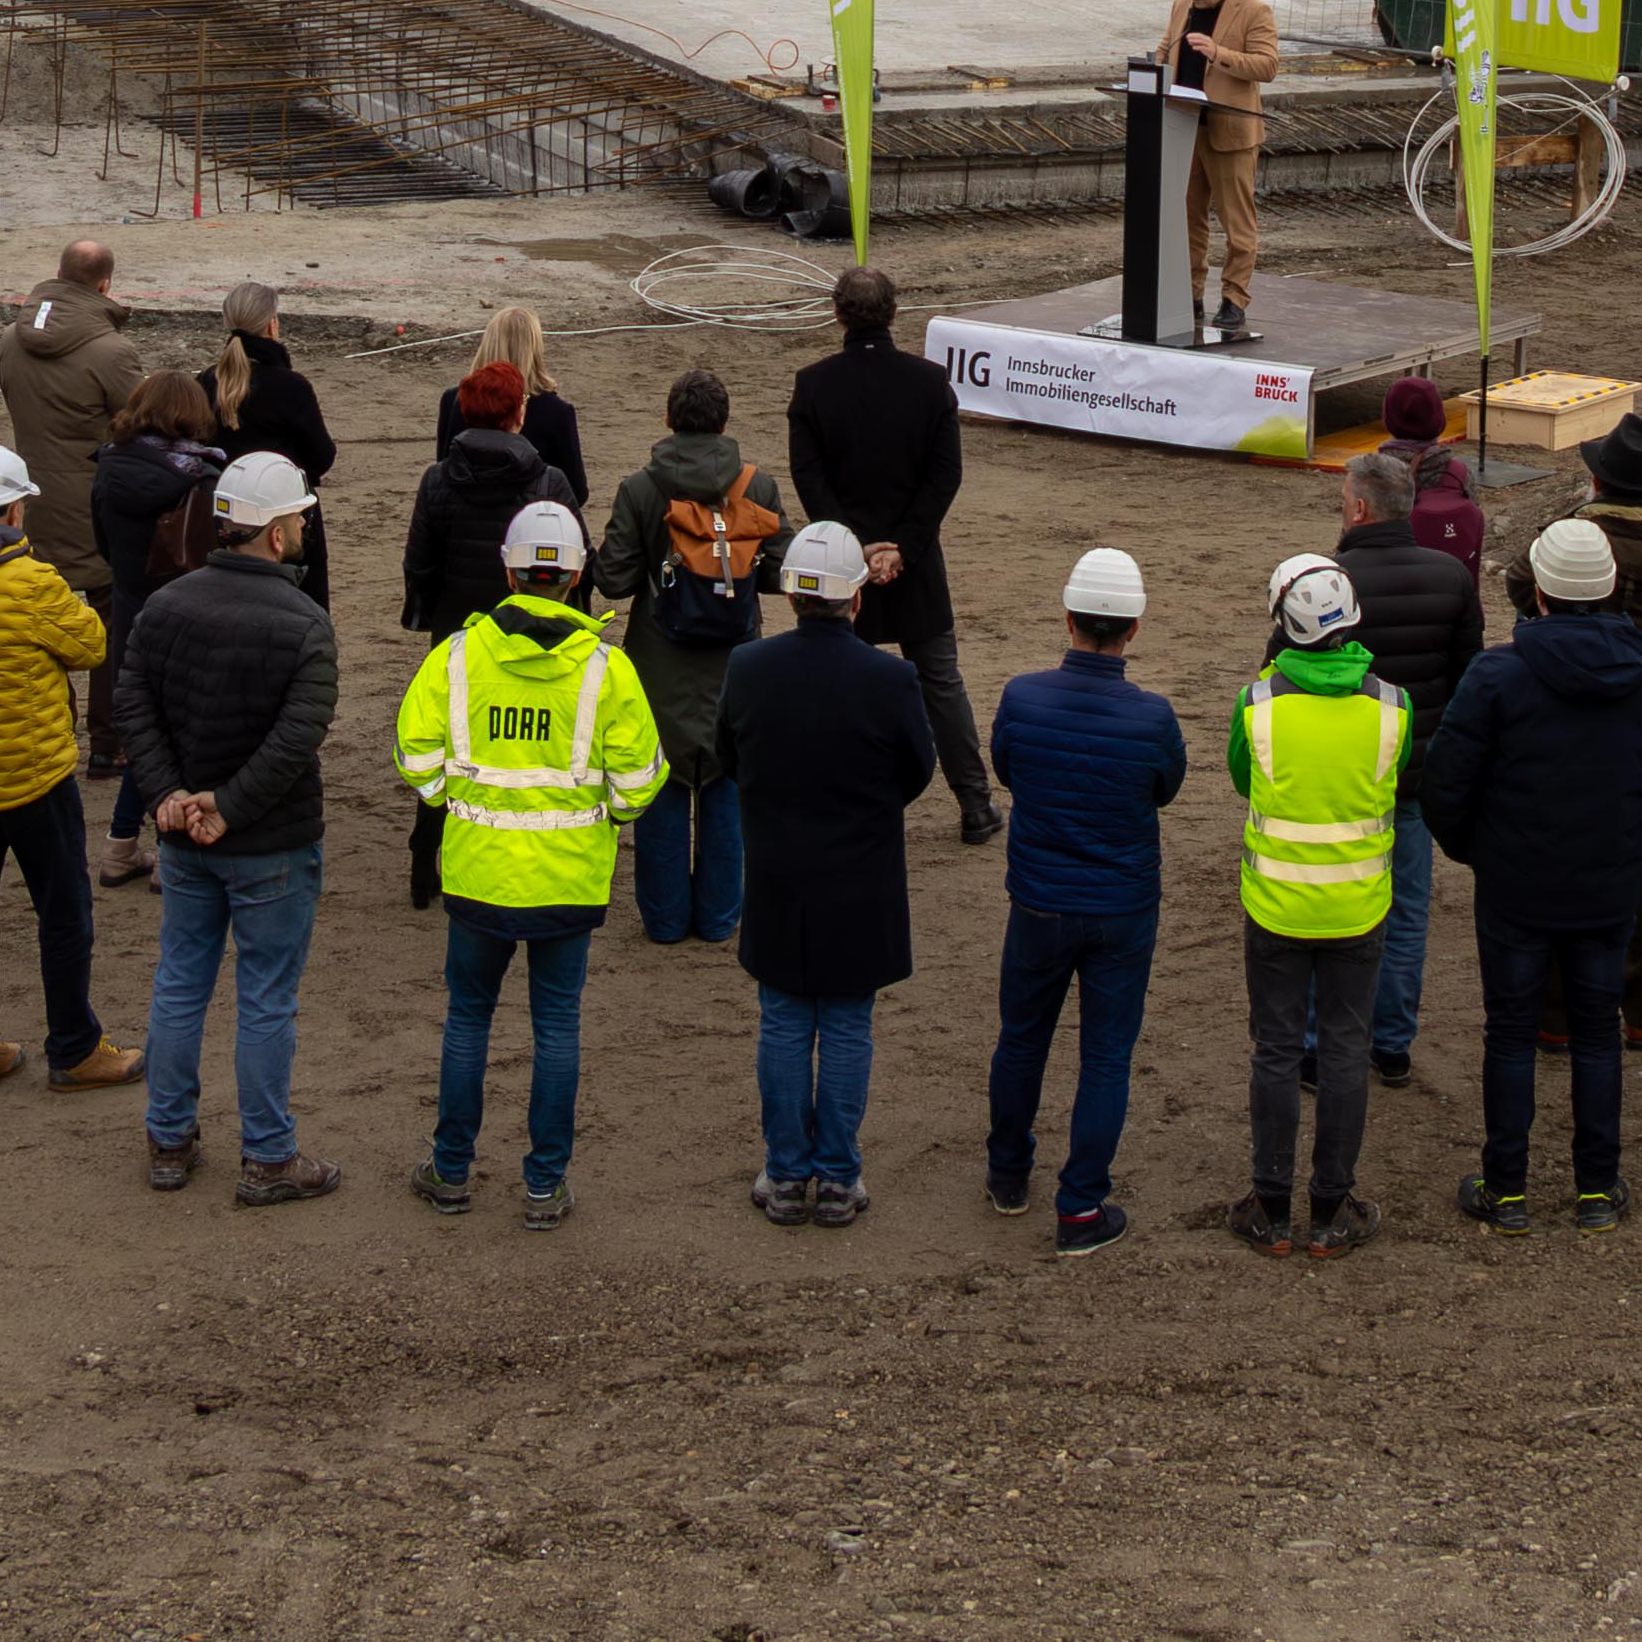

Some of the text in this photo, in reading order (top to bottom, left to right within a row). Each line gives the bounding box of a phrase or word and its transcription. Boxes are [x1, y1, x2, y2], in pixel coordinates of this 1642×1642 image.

[946, 347, 1096, 388] IIG Innsbrucker
[1255, 373, 1291, 389] INNS'
[1005, 377, 1177, 418] Immobiliengesellschaft
[1254, 387, 1299, 404] BRUCK
[489, 706, 551, 742] PORR
